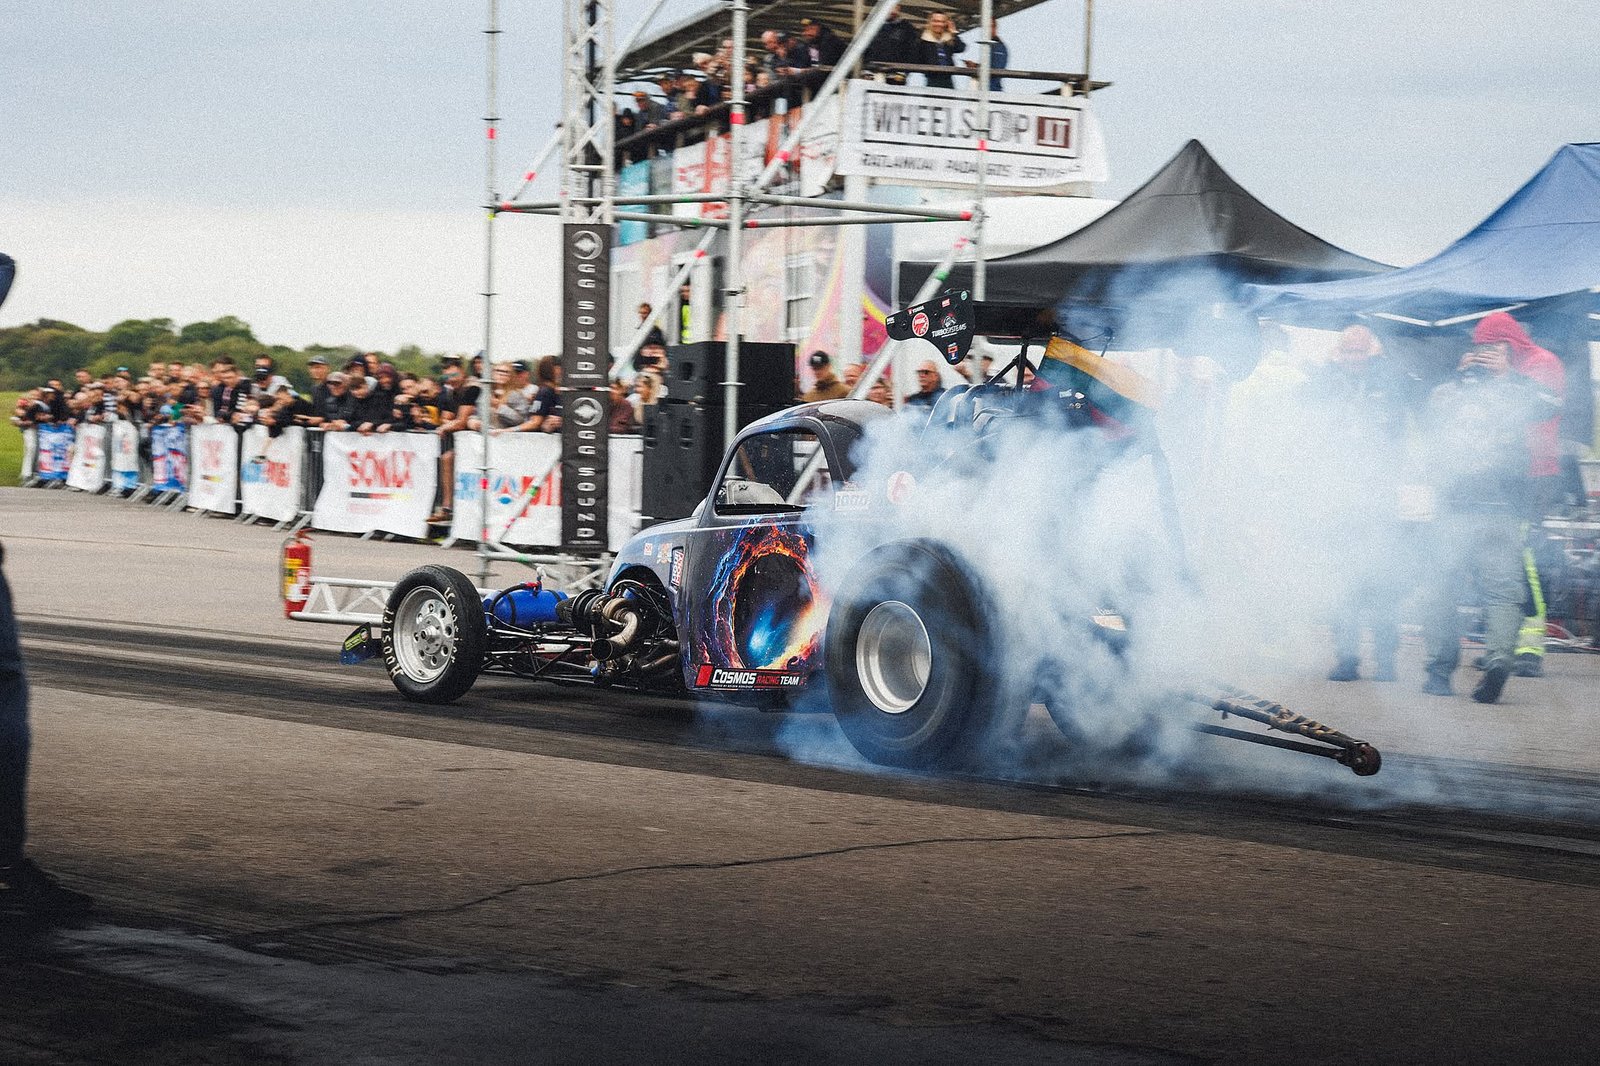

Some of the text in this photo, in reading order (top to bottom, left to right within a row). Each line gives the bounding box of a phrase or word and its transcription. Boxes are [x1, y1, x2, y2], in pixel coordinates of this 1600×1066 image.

[873, 102, 1029, 143] WHEELSOP
[577, 263, 596, 288] GG
[577, 300, 596, 371] SOUND
[577, 430, 596, 455] GG
[577, 467, 596, 538] SOUND
[711, 668, 800, 686] COSMOS RACING TEAM
